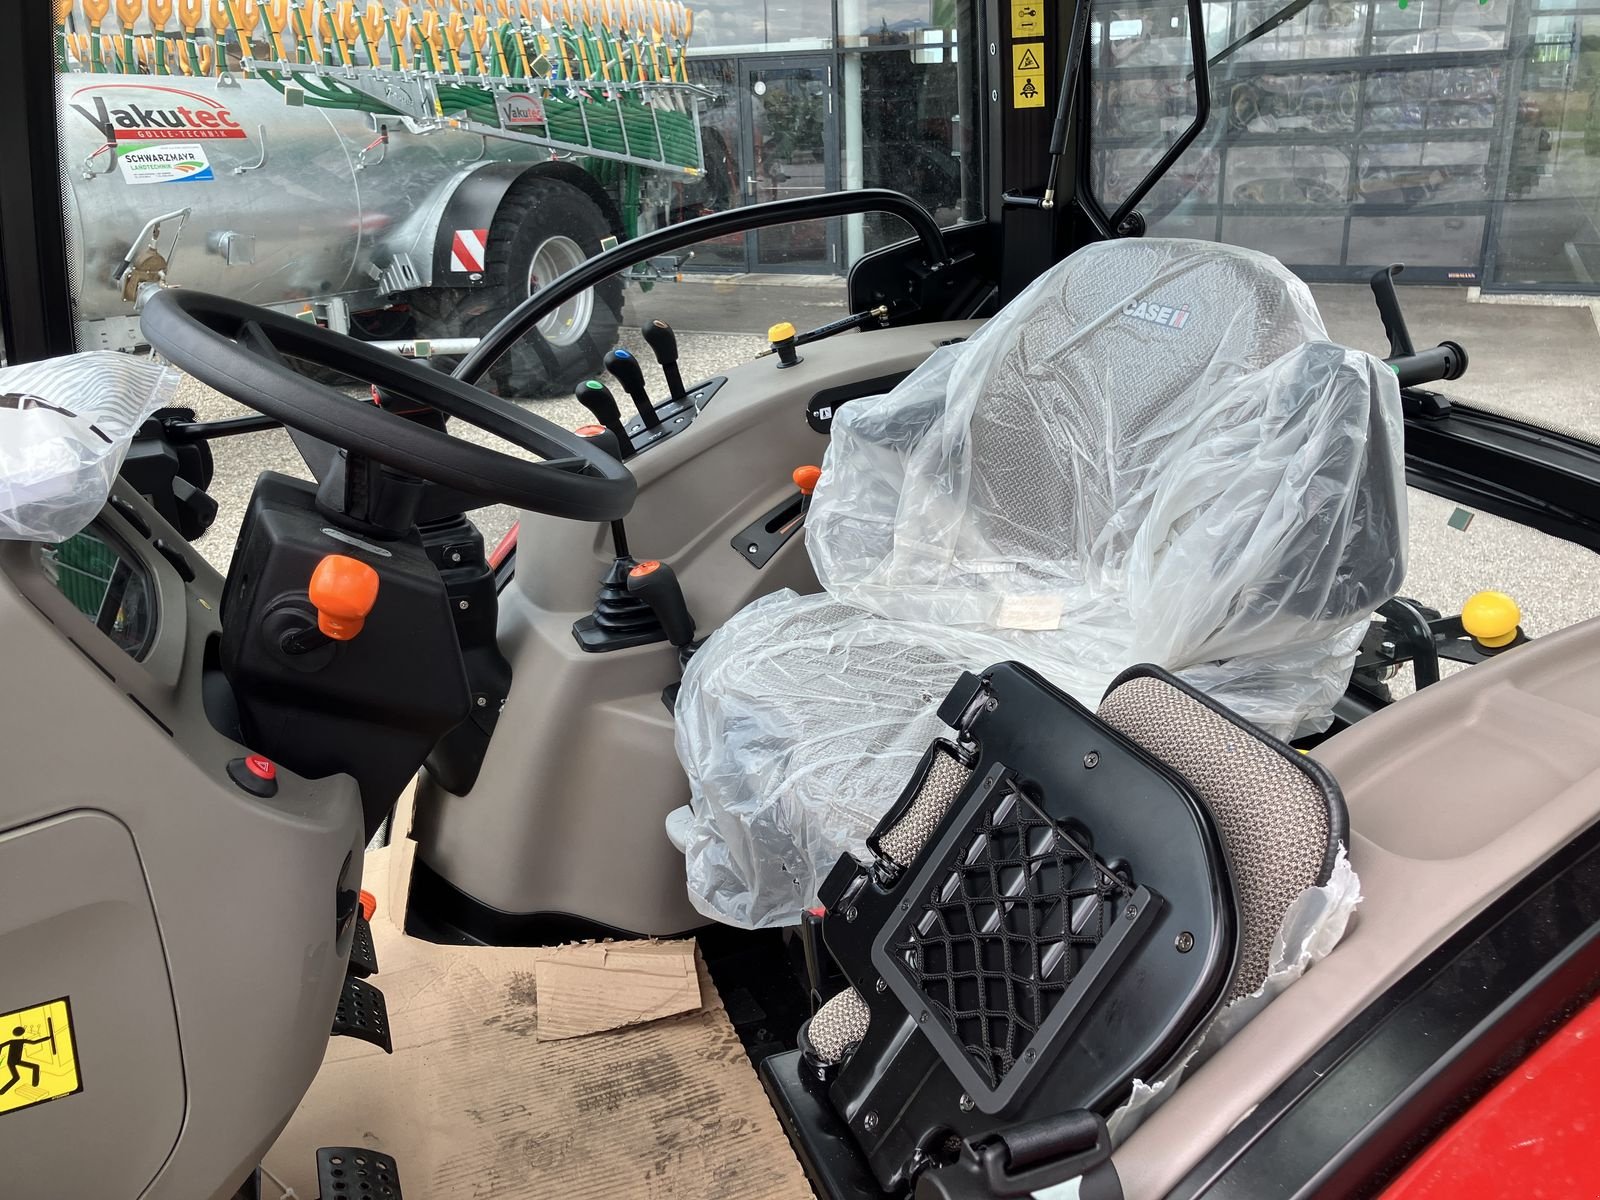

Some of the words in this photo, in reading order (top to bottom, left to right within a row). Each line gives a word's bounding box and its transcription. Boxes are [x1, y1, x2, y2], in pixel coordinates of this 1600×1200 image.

[69, 96, 240, 139] Vakutec
[503, 103, 541, 121] Vakutec
[125, 153, 196, 163] SCHWARZMAYR
